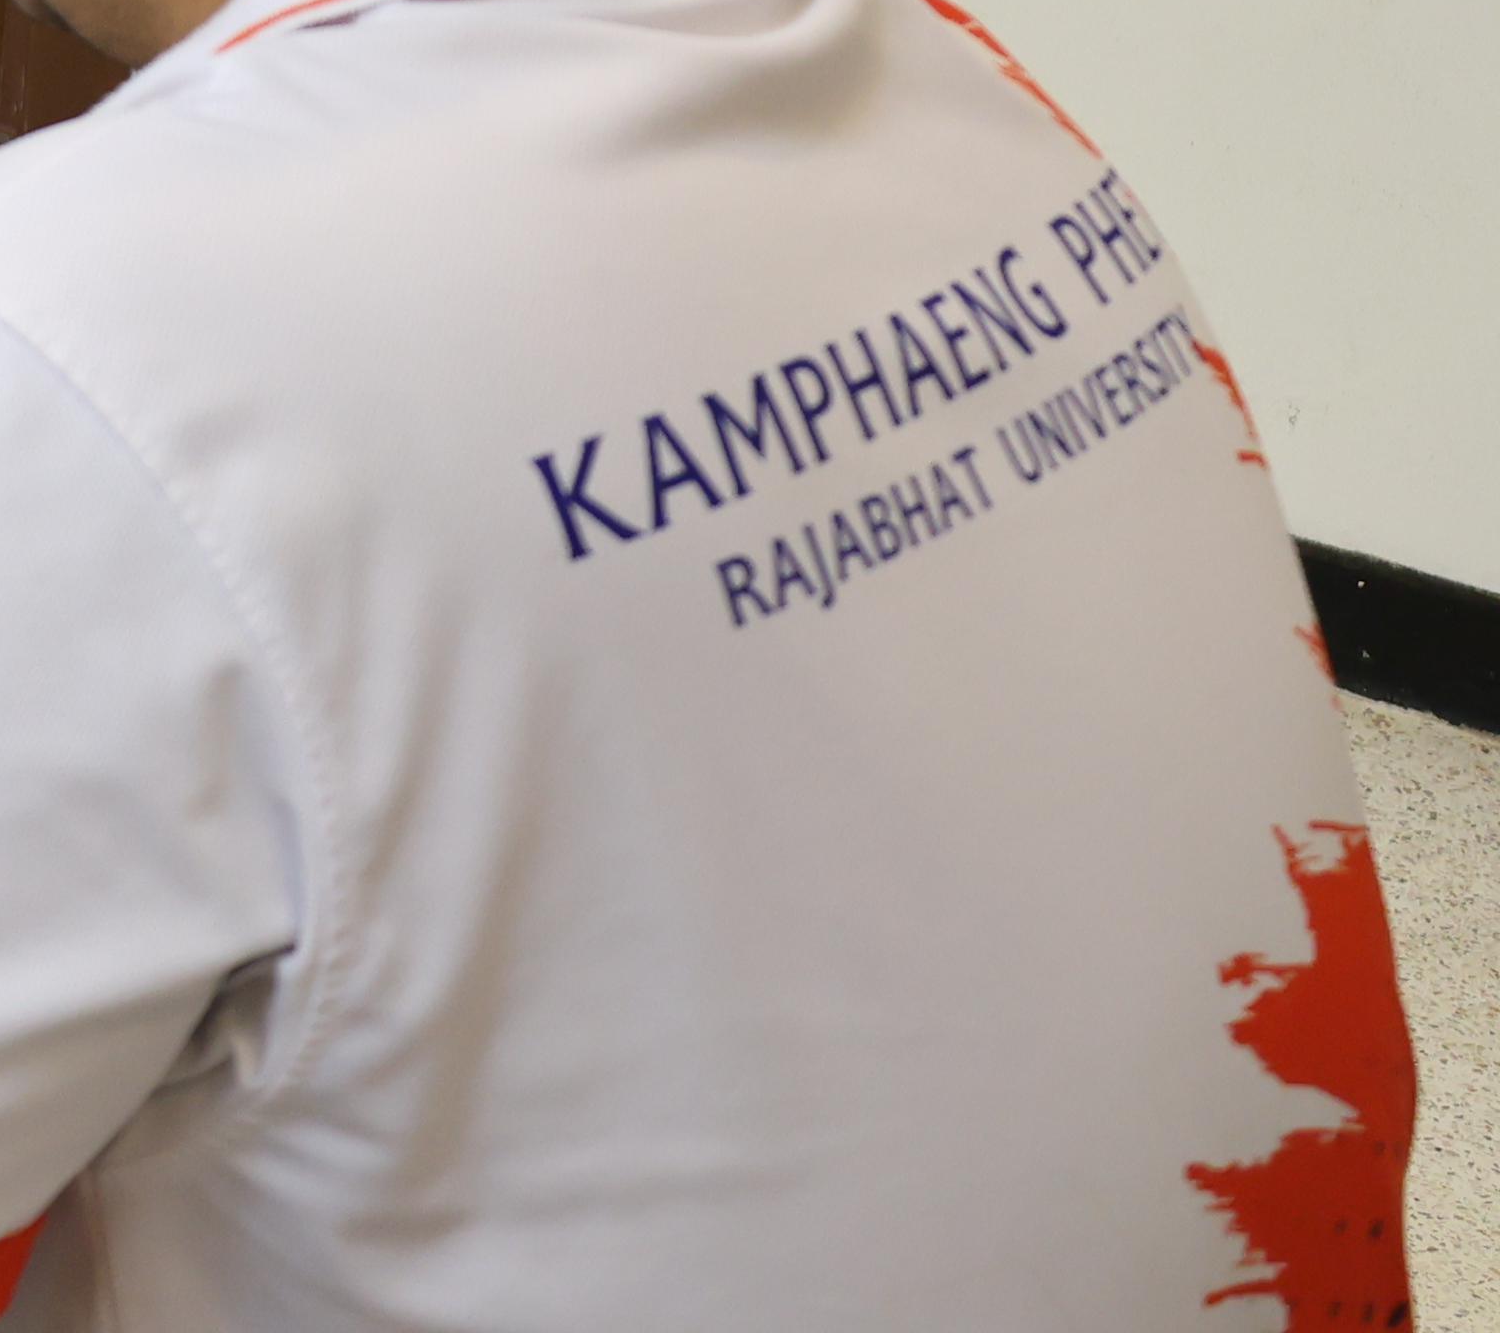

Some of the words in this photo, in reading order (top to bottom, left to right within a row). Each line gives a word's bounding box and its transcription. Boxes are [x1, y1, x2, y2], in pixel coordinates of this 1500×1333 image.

[533, 245, 1068, 562] KAMPHAENG
[715, 447, 997, 627] RAJABHAT
[997, 304, 1192, 485] UNIVERSITY
